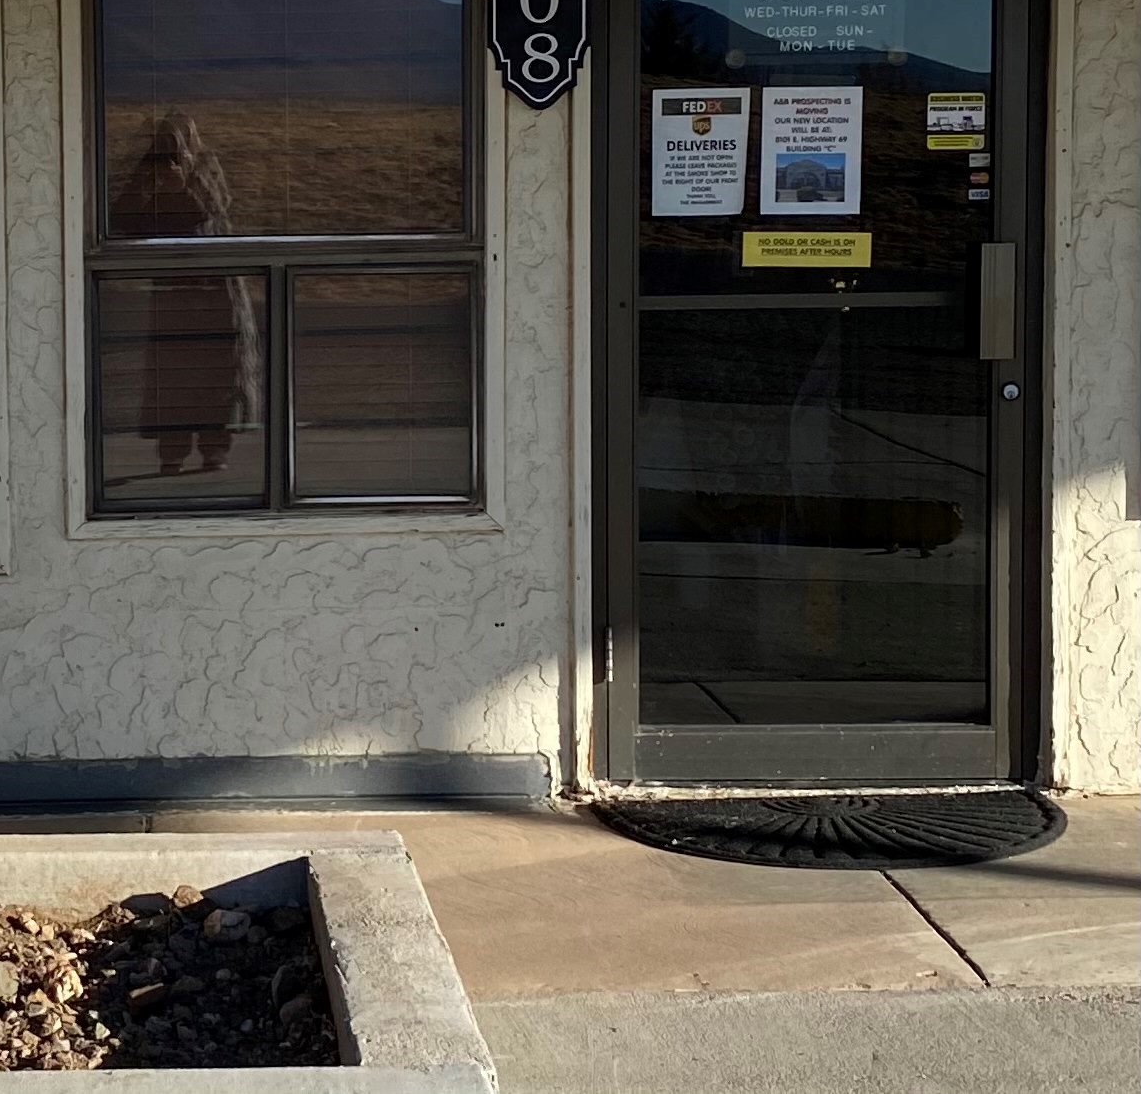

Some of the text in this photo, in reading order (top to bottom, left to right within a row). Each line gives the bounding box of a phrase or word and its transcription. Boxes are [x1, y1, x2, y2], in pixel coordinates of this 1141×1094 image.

[767, 26, 817, 37] CLOSED
[682, 100, 723, 113] FEDEX
[666, 139, 737, 152] DELIVERIES
[758, 238, 771, 246] NO
[773, 238, 795, 246] GOLD
[797, 238, 808, 246] OR
[810, 238, 832, 246] CASH
[761, 248, 852, 256] PREMISES AFTER HOURS
